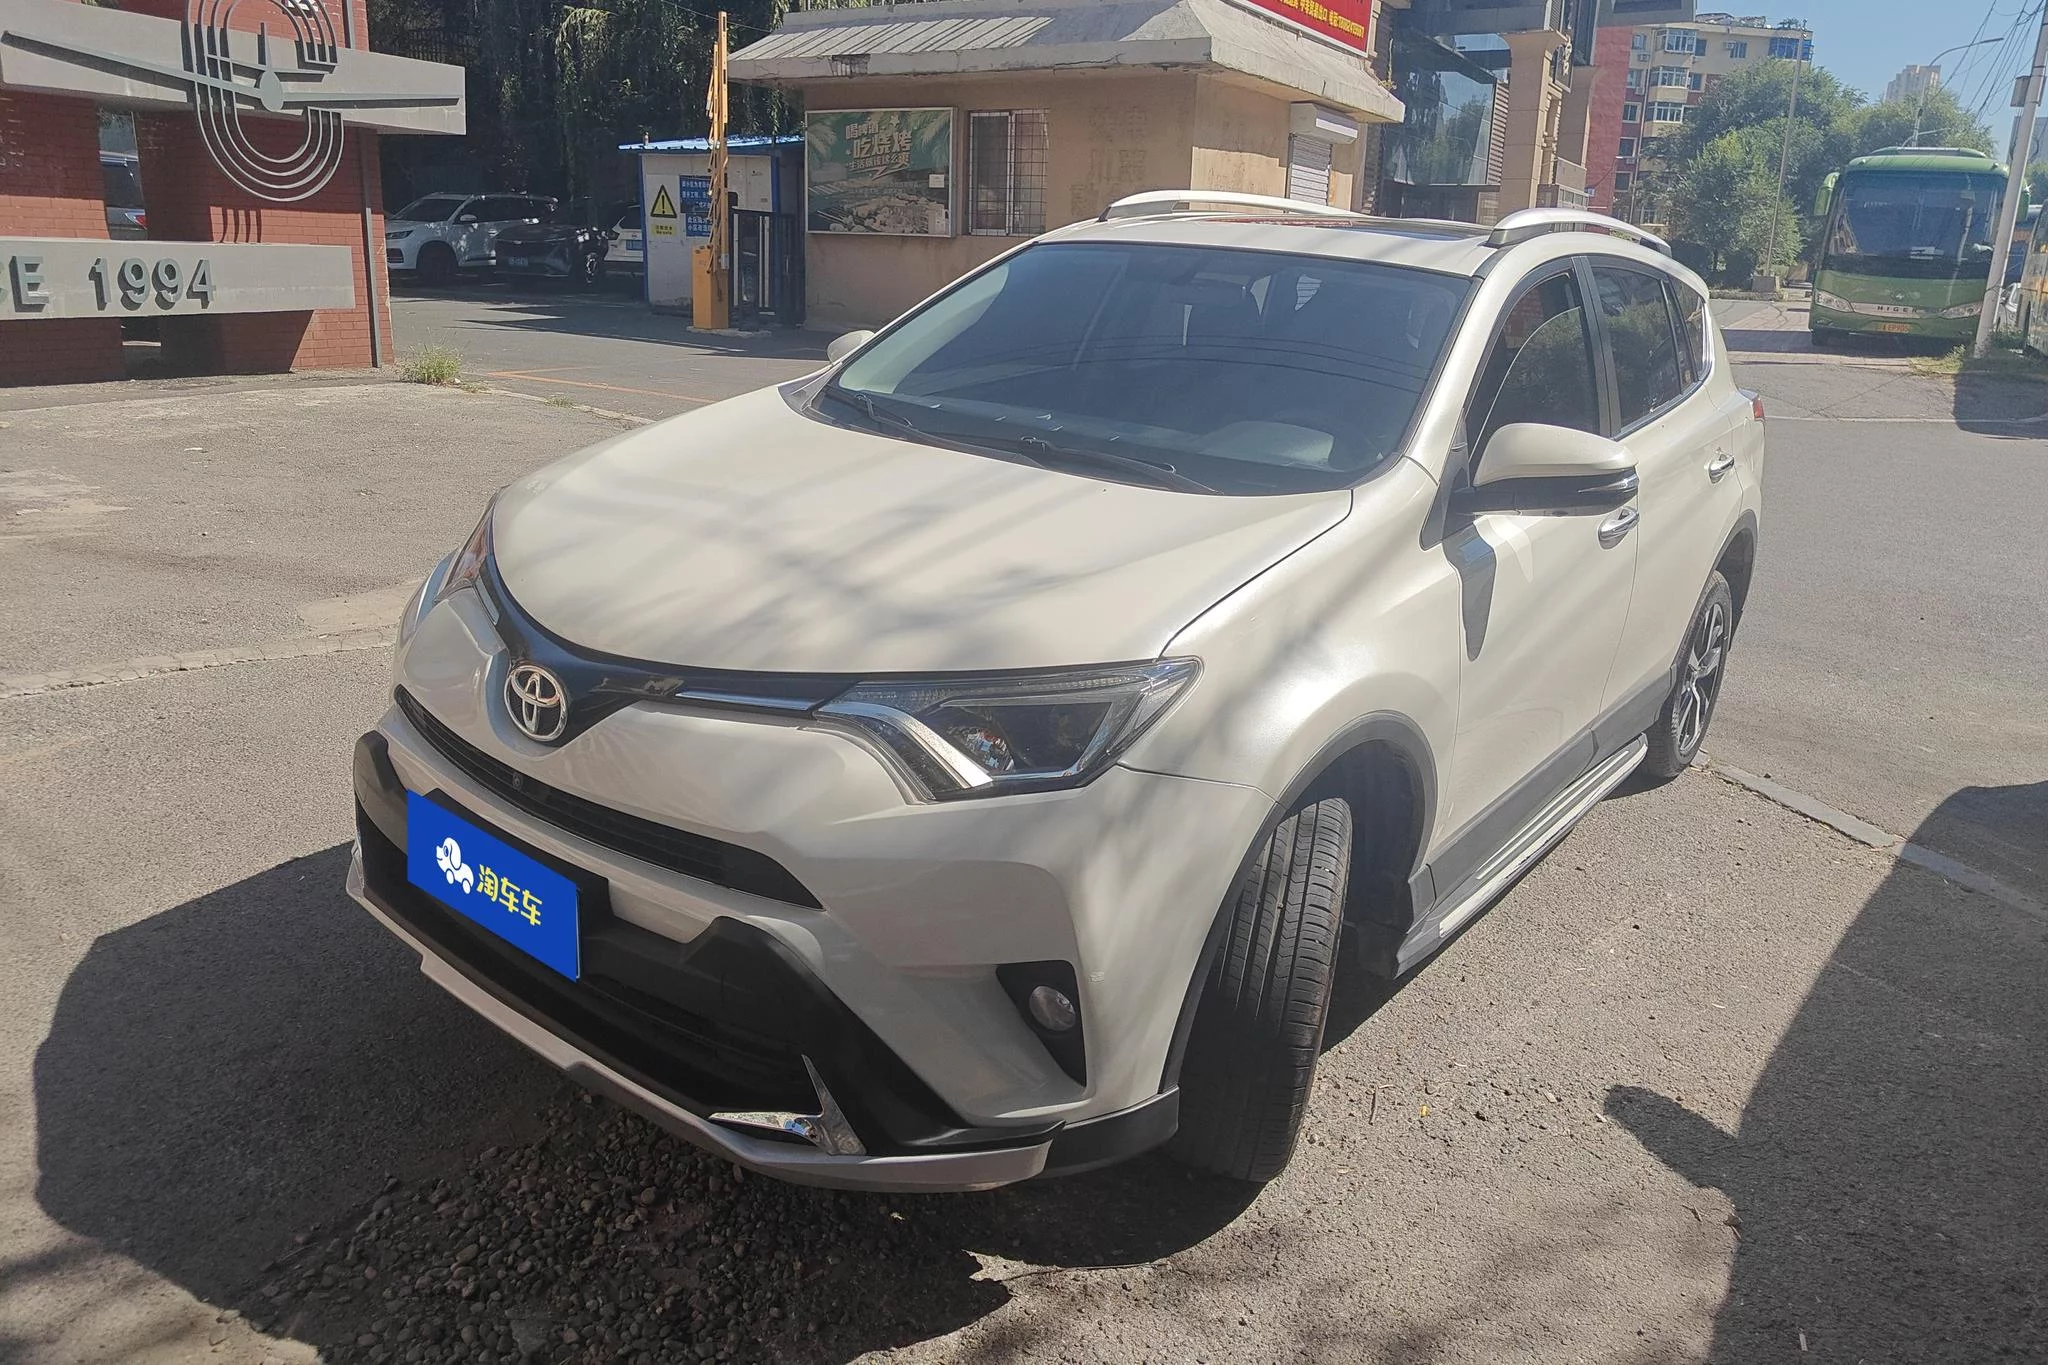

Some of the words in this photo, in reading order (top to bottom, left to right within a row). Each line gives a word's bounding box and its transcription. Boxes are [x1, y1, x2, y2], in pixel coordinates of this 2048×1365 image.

[853, 130, 912, 158] 吃烧烤
[89, 257, 215, 311] 1994
[1877, 305, 1917, 313] HIGER
